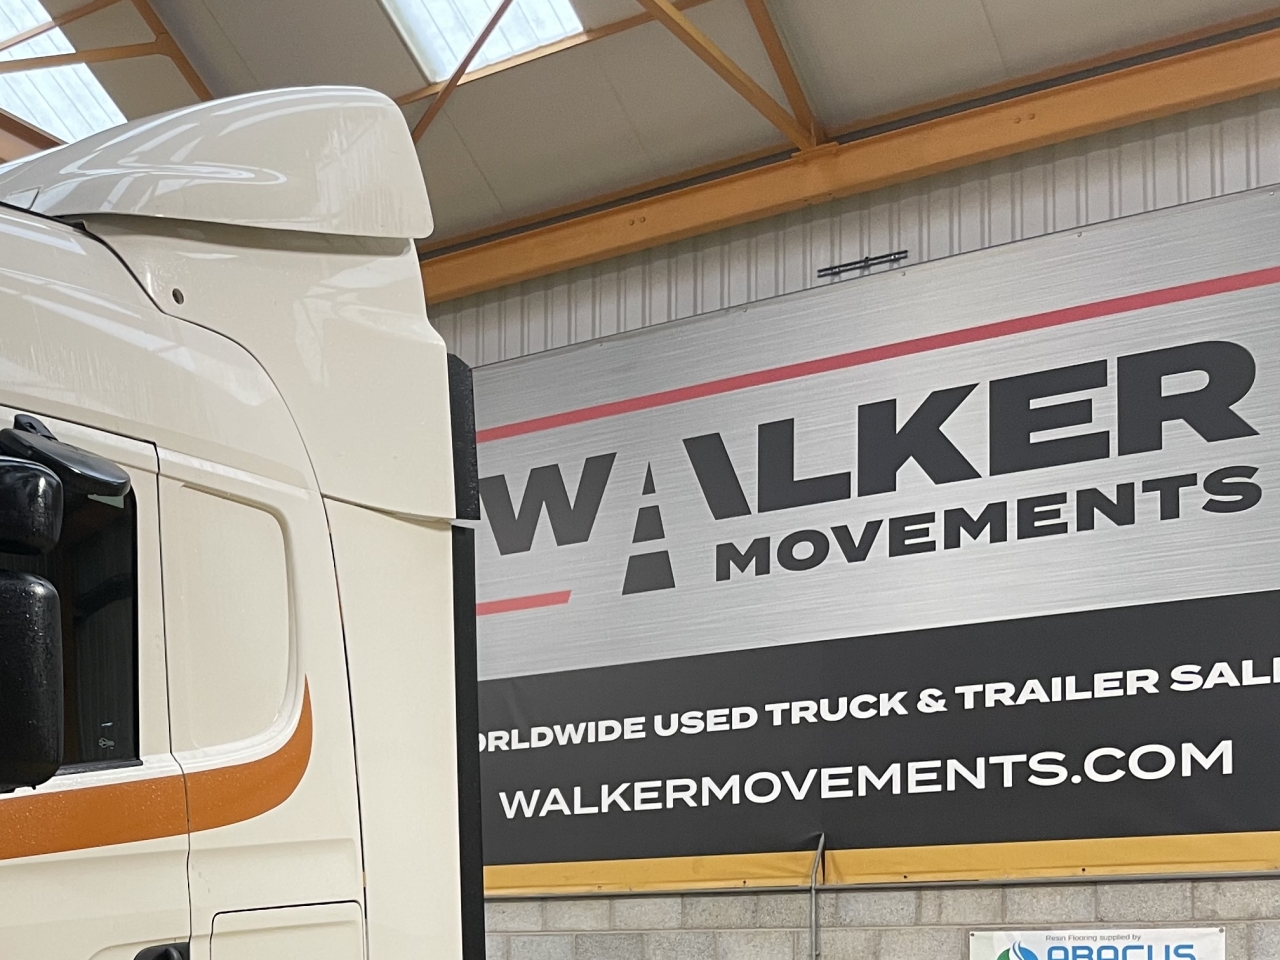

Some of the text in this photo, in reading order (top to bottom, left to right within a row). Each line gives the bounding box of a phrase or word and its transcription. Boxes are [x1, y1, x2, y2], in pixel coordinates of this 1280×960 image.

[477, 341, 1260, 596] WALKER
[716, 465, 1262, 582] MOVEMENTS
[478, 717, 647, 753] RLDWIDE
[654, 707, 759, 737] USED
[765, 692, 909, 726] TRUCK
[917, 688, 948, 714] &
[955, 669, 1160, 710] TRAILER
[498, 740, 1233, 819] WALKERMOVEMENTS.COM
[1045, 933, 1142, 943] Resin Flooring supplied by
